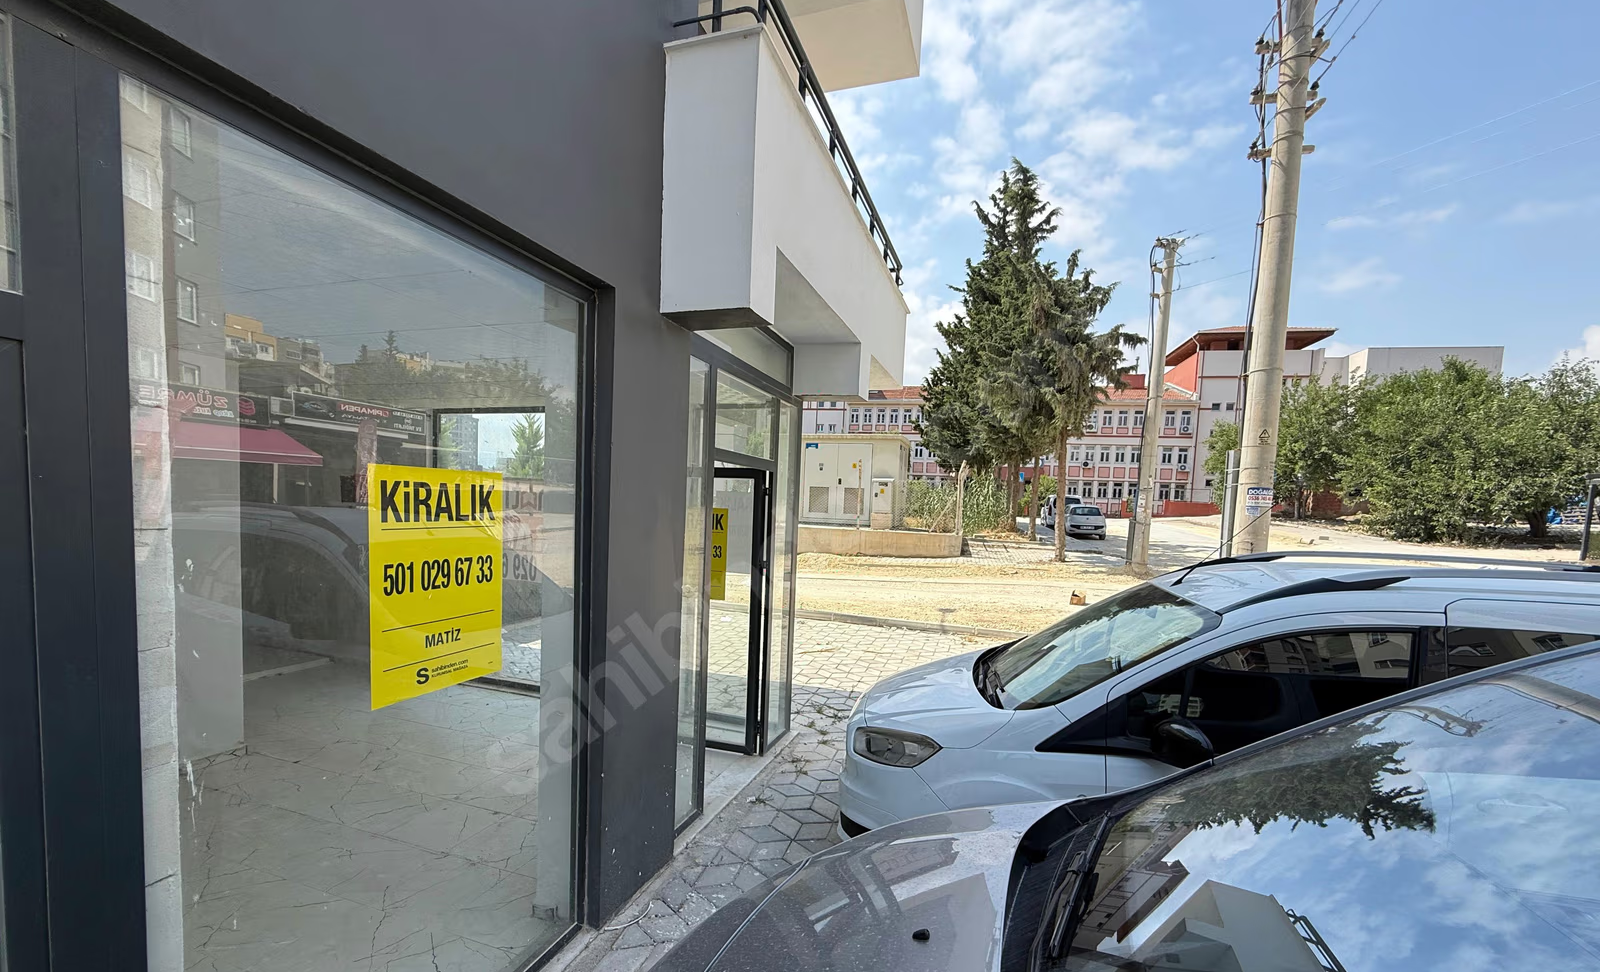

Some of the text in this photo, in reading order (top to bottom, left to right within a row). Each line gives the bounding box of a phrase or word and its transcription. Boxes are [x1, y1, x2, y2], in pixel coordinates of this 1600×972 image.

[383, 555, 494, 596] 501 029 67 33
[425, 627, 461, 649] MATİZ
[431, 659, 469, 673] sahibinden.com
